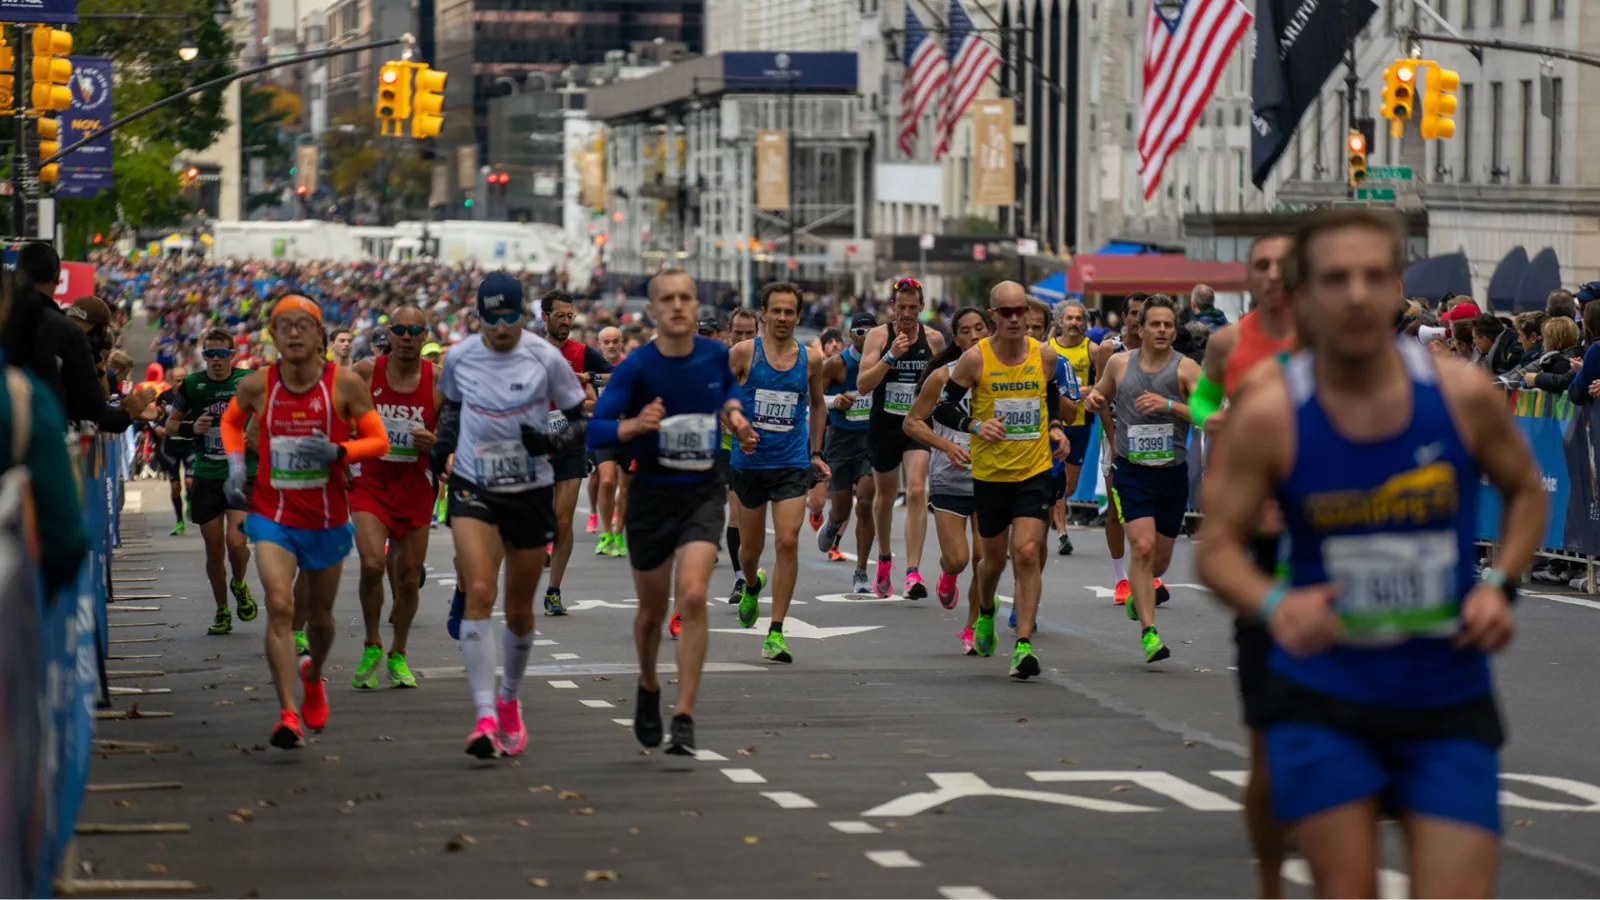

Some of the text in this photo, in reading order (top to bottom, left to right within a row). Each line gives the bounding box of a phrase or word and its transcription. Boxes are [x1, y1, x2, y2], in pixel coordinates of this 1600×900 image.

[1279, 0, 1321, 61] ARLTO
[991, 381, 1039, 392] SWEDEN
[376, 403, 425, 421] WSX
[766, 403, 786, 417] 1737
[1005, 410, 1031, 426] 3048
[676, 432, 702, 449] 1461
[1138, 438, 1163, 451] 3399
[491, 455, 521, 476] 1435
